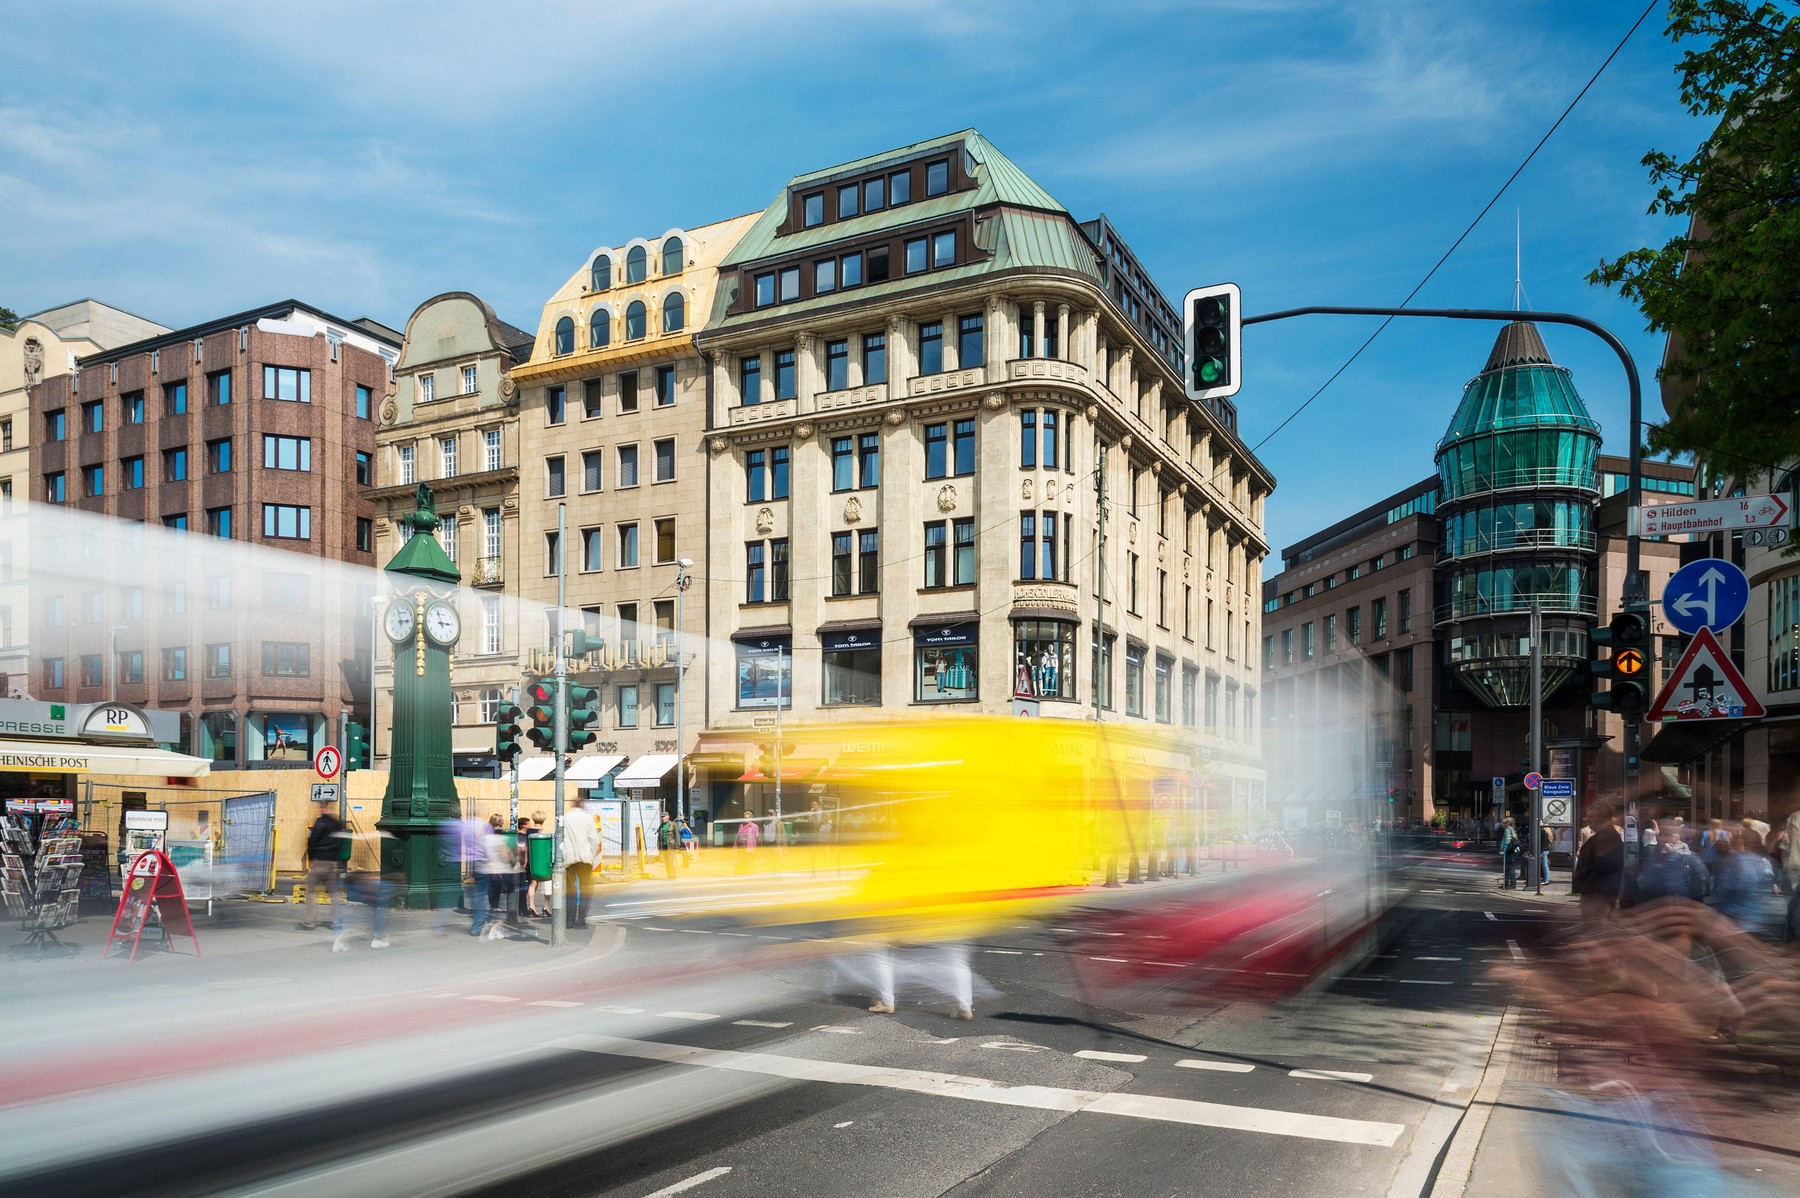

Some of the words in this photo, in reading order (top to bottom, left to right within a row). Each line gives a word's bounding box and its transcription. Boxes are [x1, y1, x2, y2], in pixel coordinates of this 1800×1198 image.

[1661, 507, 1697, 518] Hilden
[1740, 501, 1749, 510] 16
[1661, 516, 1723, 531] Hauptbahnhof
[106, 709, 128, 724] RP
[842, 741, 900, 753] WEMPE
[60, 757, 90, 769] POST
